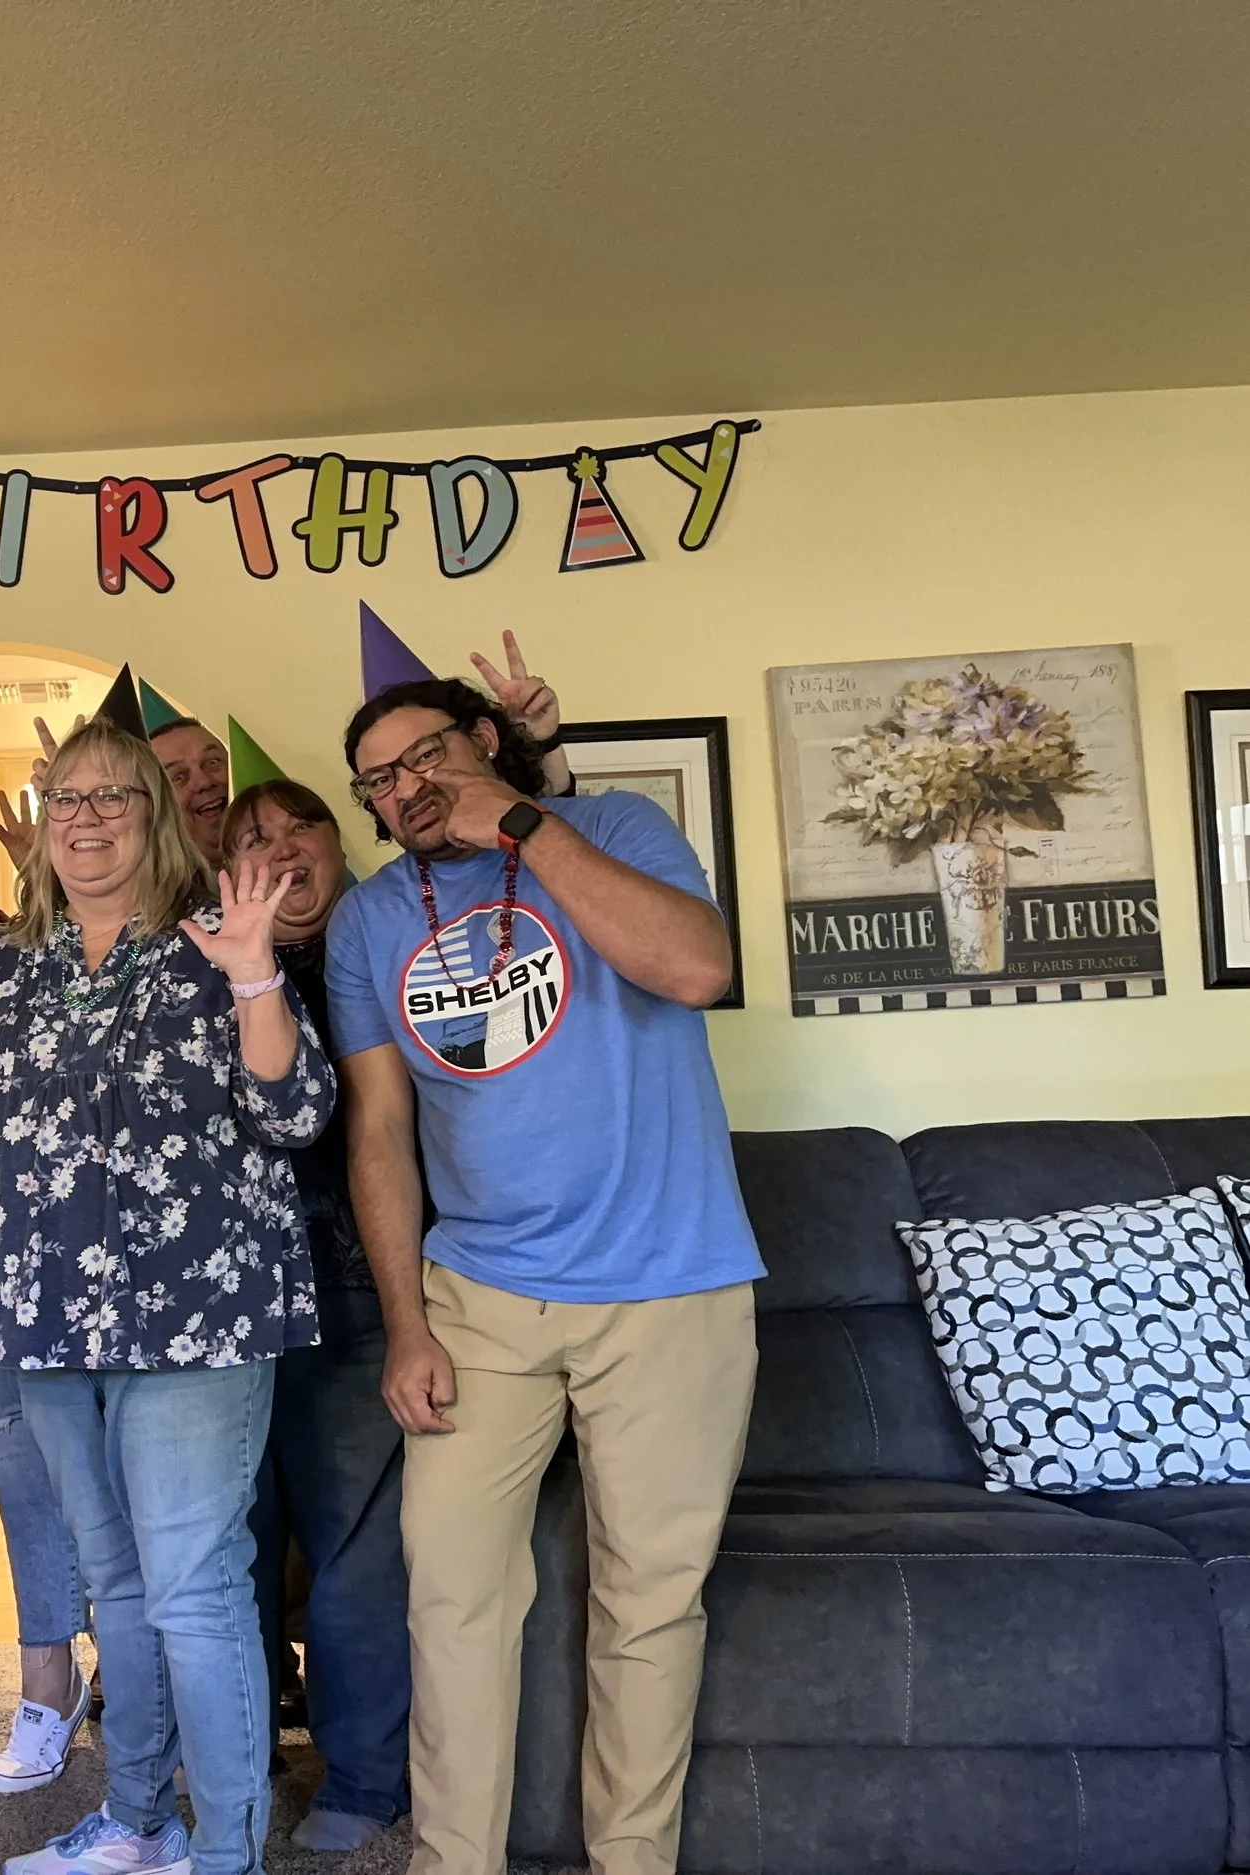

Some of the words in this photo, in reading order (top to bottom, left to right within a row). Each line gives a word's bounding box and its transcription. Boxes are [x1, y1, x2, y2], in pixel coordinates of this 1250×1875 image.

[793, 697, 883, 715] PARIS
[791, 905, 937, 955] MARCHÉ
[1021, 898, 1160, 943] FLEURS
[407, 951, 555, 1016] SHELBY
[843, 972, 864, 985] DE
[868, 971, 888, 982] LA
[893, 968, 924, 981] RUE
[1033, 959, 1074, 973] PARIS
[1078, 955, 1139, 971] FRANCE
